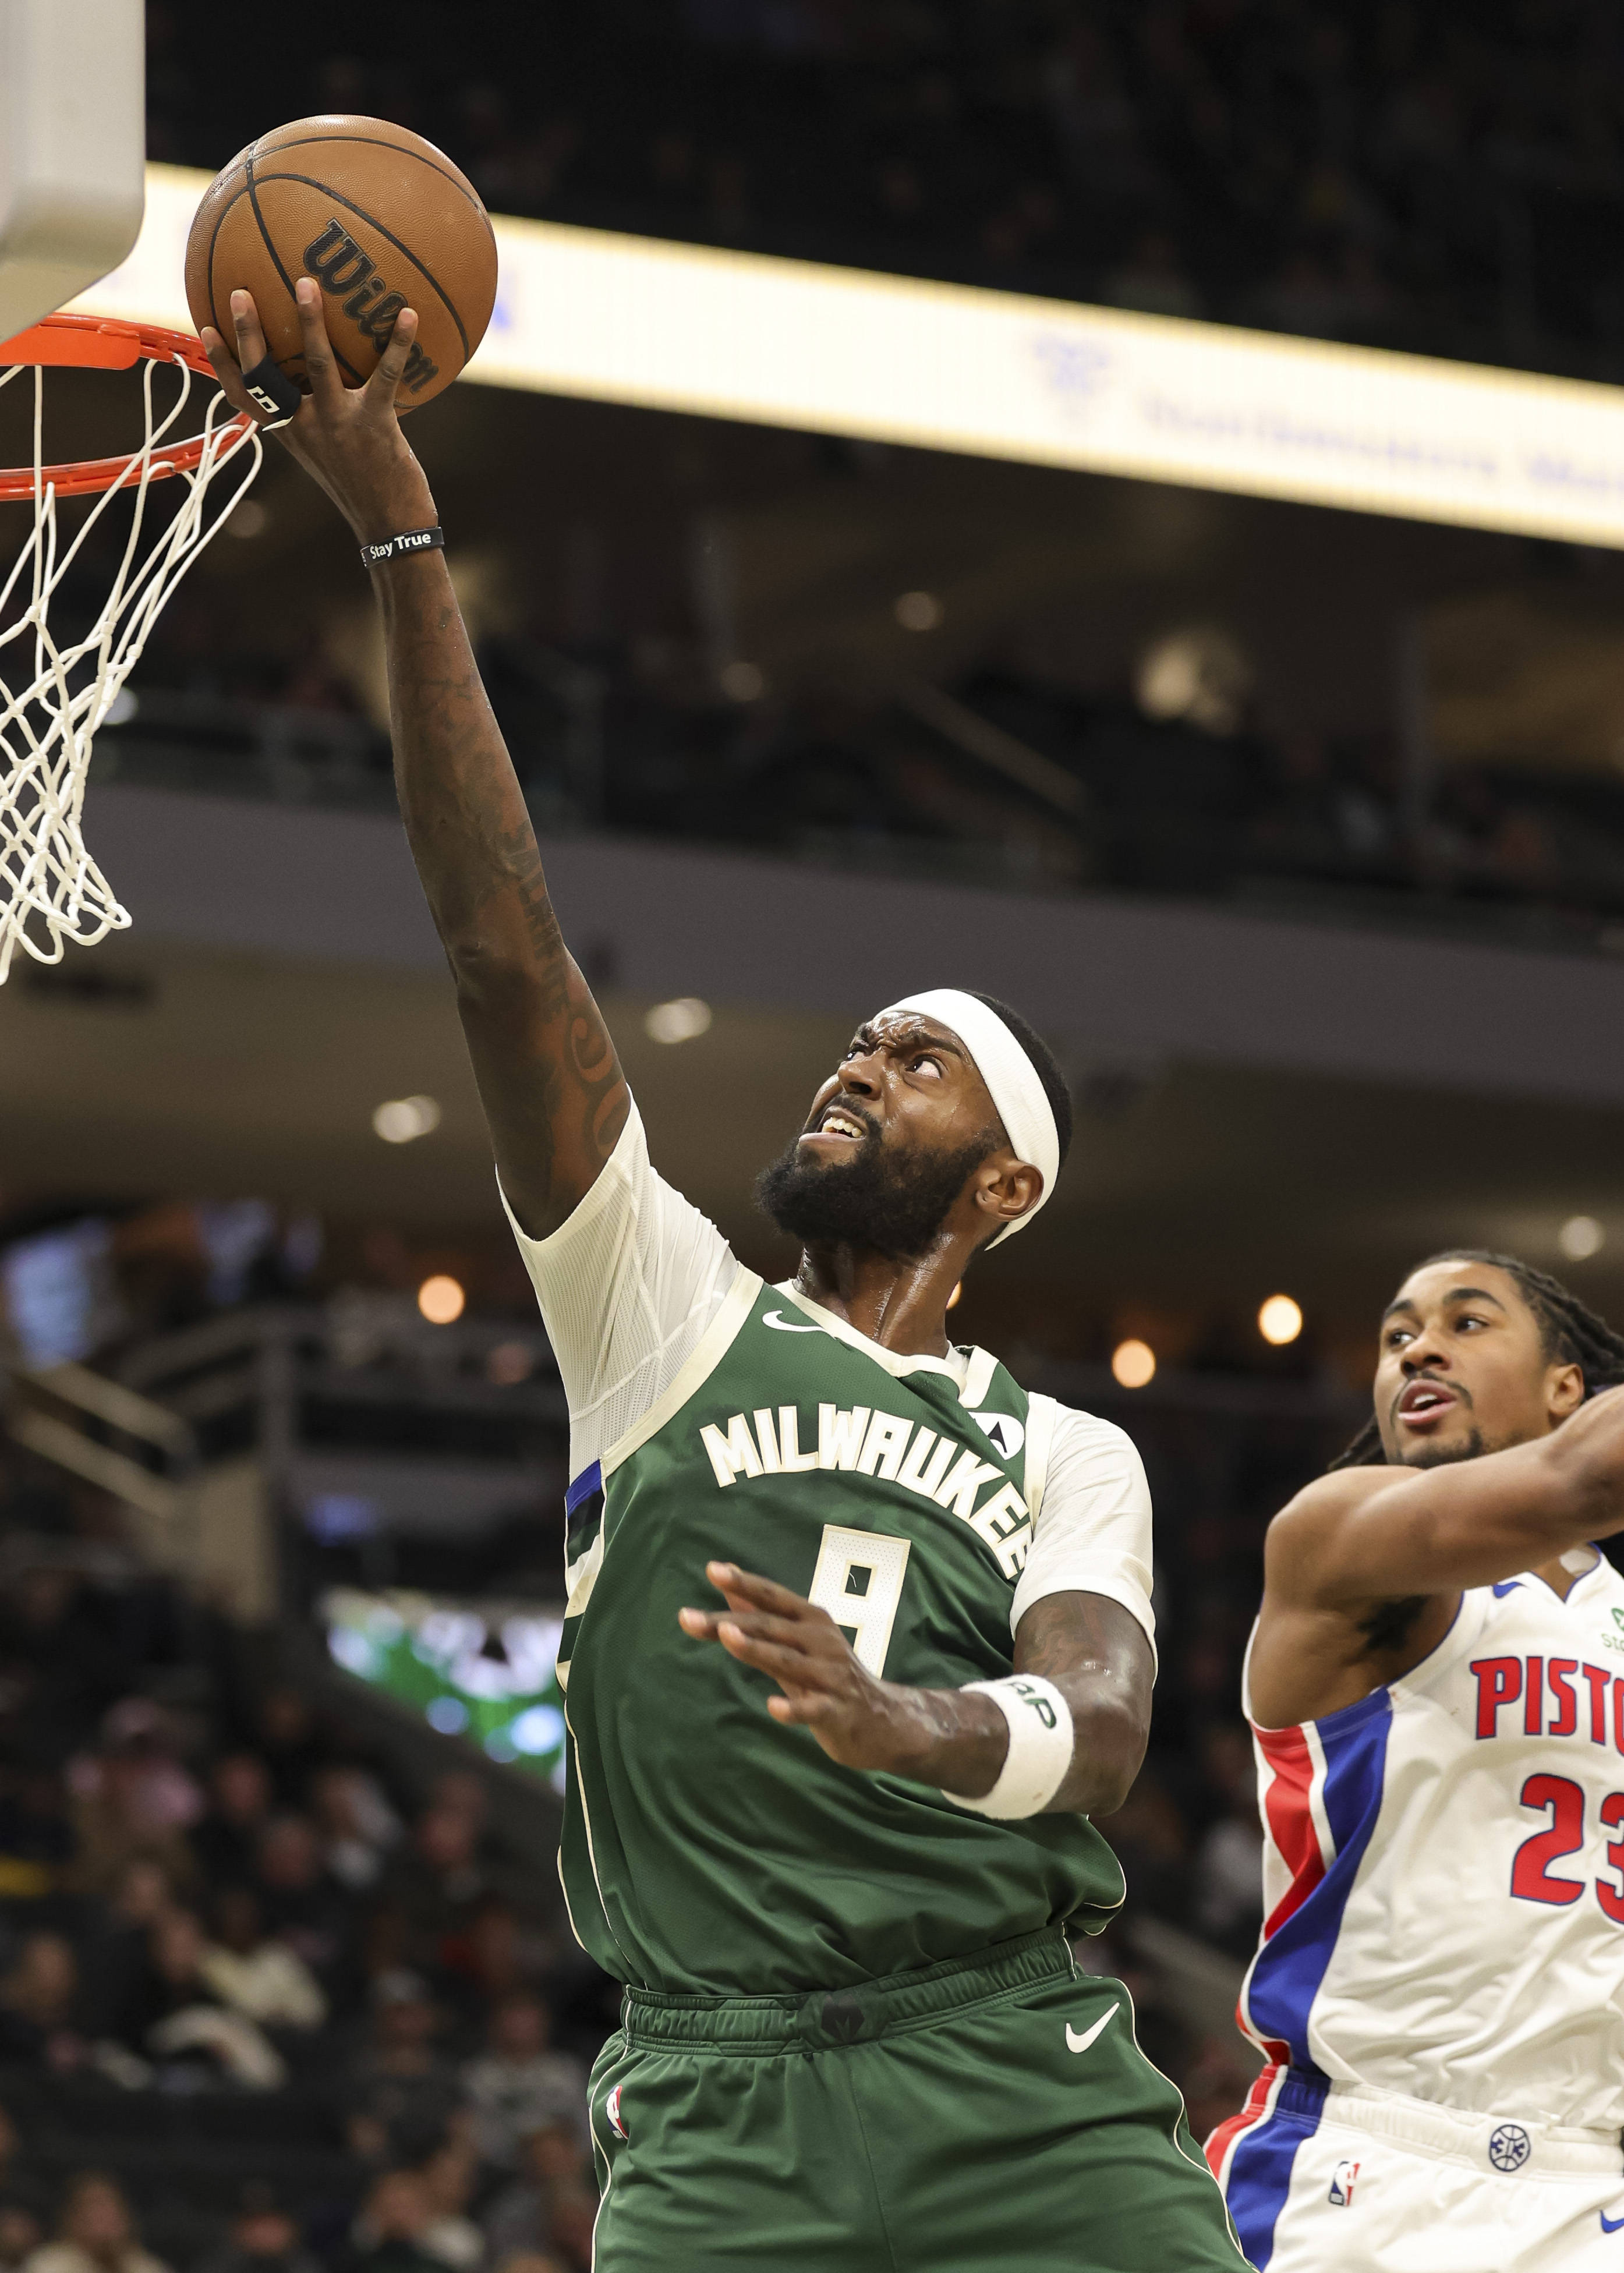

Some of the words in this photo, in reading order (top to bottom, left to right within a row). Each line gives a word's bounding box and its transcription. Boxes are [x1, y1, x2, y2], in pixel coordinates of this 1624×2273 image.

[303, 217, 439, 393] Wiln
[370, 543, 393, 560] Stay
[394, 533, 431, 550] True
[699, 1403, 1033, 1580] MILWAUKEE
[808, 1524, 911, 1679] 9
